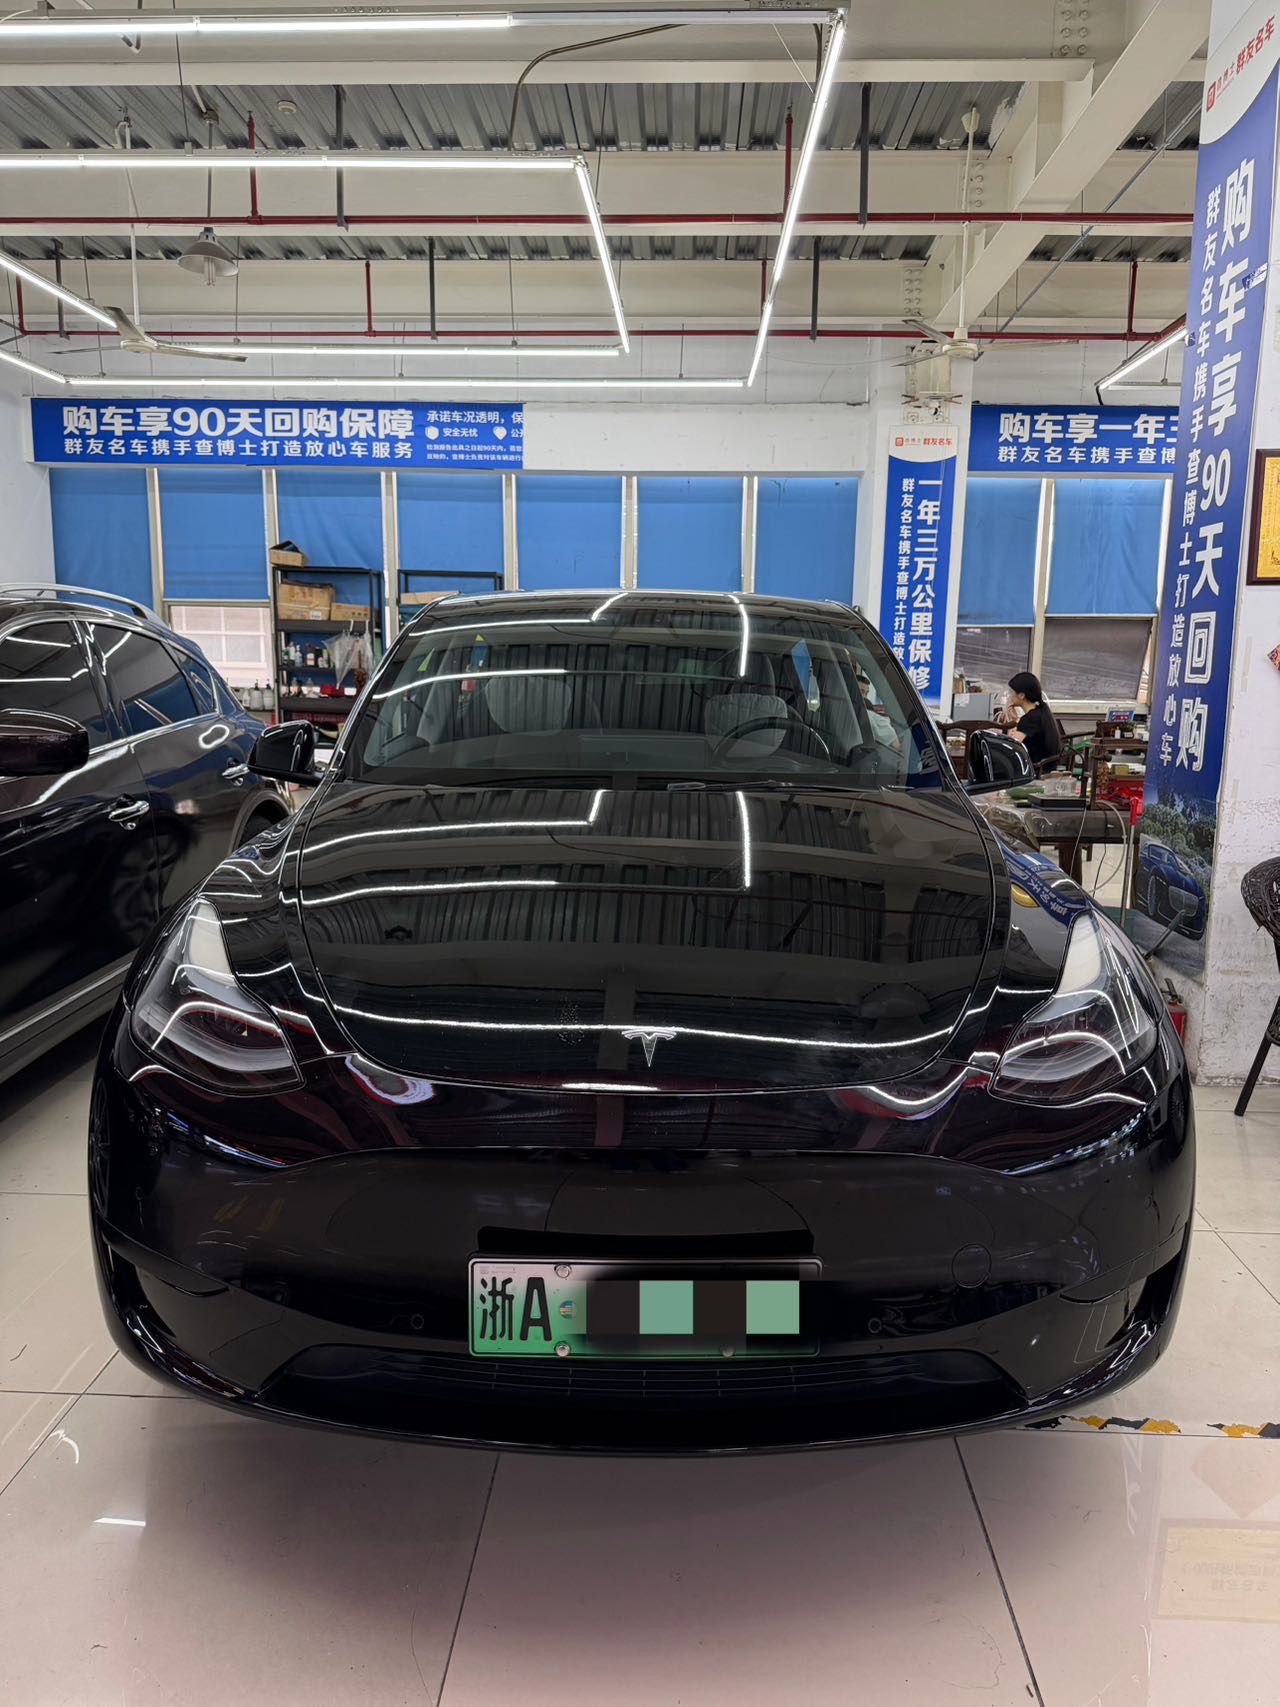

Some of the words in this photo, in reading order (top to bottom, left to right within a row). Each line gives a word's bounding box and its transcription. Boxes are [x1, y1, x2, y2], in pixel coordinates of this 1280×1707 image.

[1236, 14, 1275, 75] 群友名车
[62, 405, 415, 438] 购车享90天回购保障
[64, 438, 414, 460] 群友名车携手查博士打造放心车服务
[442, 428, 478, 438] 安全无忧
[997, 445, 1177, 465] 群友名车携手查博
[1159, 184, 1222, 767] 群友名车携手查博士打造放心车
[1175, 158, 1255, 772] 购车享90天回购
[893, 478, 915, 660] 群友名车携手查博士打造放
[907, 480, 944, 690] 一年三万公里保修
[479, 1276, 553, 1342] 浙A
